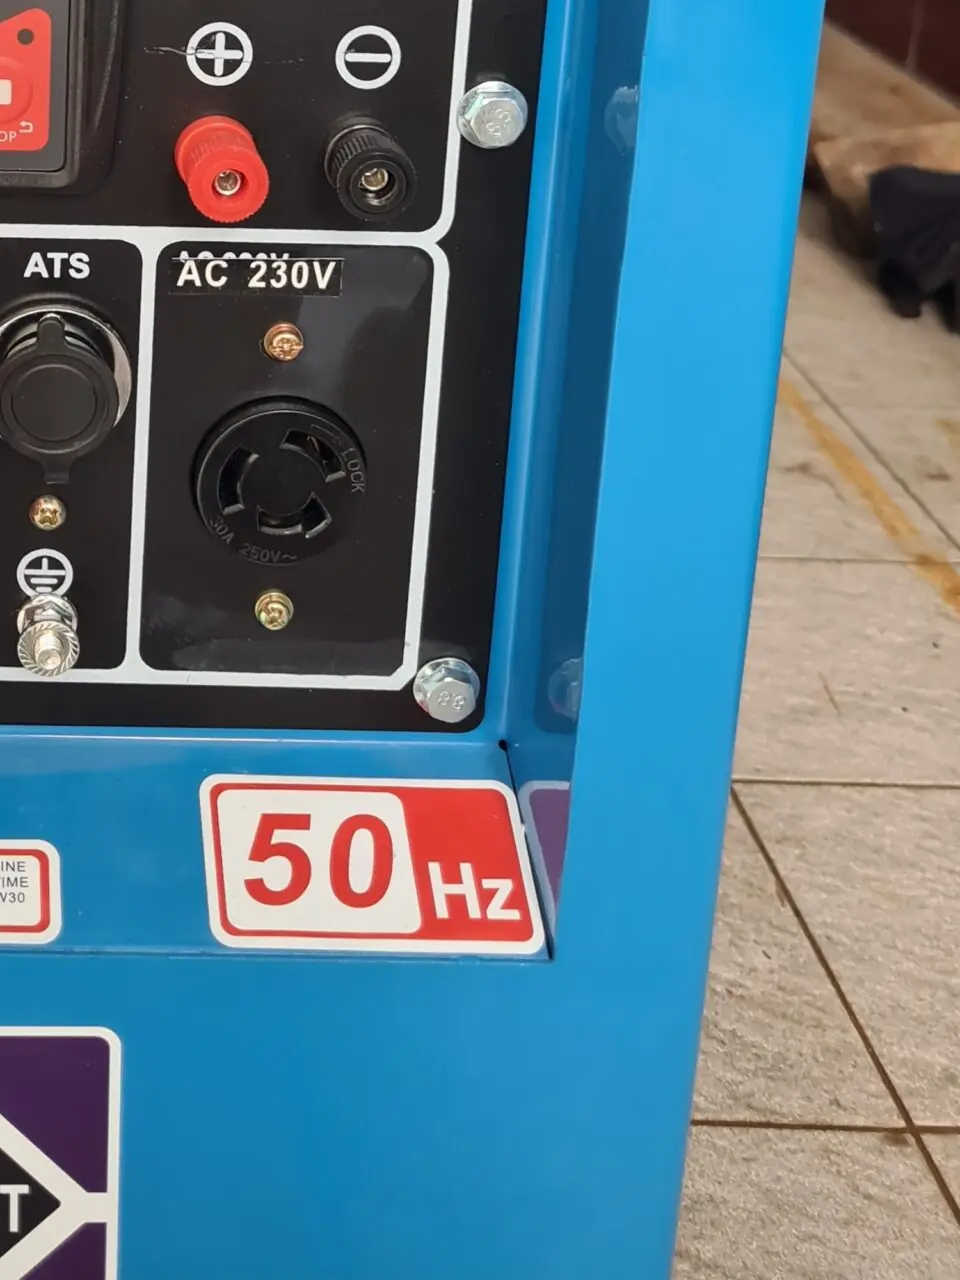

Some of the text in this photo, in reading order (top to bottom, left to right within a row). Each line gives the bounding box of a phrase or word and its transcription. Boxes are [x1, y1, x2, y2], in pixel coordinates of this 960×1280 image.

[23, 252, 90, 279] ATS
[176, 260, 336, 289] AC 230V
[340, 447, 365, 493] LOCK
[210, 516, 235, 544] 30A
[244, 813, 520, 920] 50 Hz
